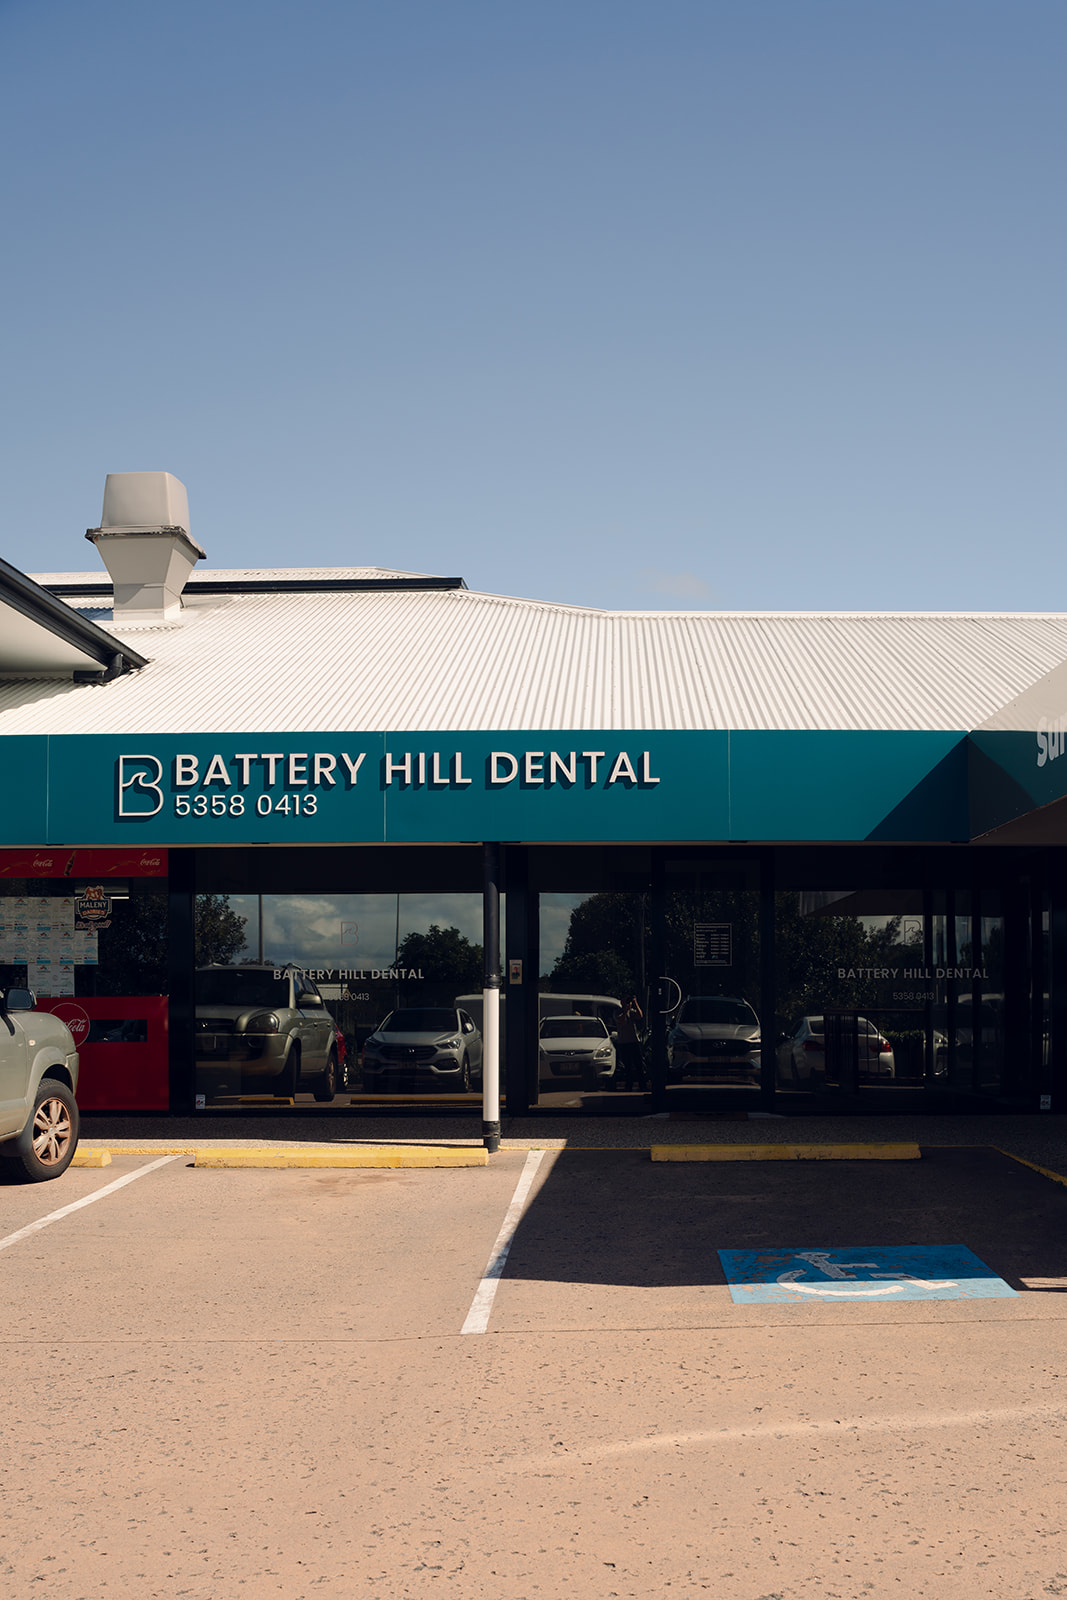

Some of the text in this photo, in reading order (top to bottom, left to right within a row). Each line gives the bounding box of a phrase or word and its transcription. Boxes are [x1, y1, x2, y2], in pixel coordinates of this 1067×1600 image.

[175, 751, 661, 786] BATTERY HILL DENTAL
[175, 794, 318, 816] 5358 0413
[79, 901, 107, 909] MALENY
[273, 968, 425, 980] BATTERY HILL DENTAL
[837, 968, 989, 979] BATTERY HILL DENTAL
[351, 992, 370, 1001] 0413
